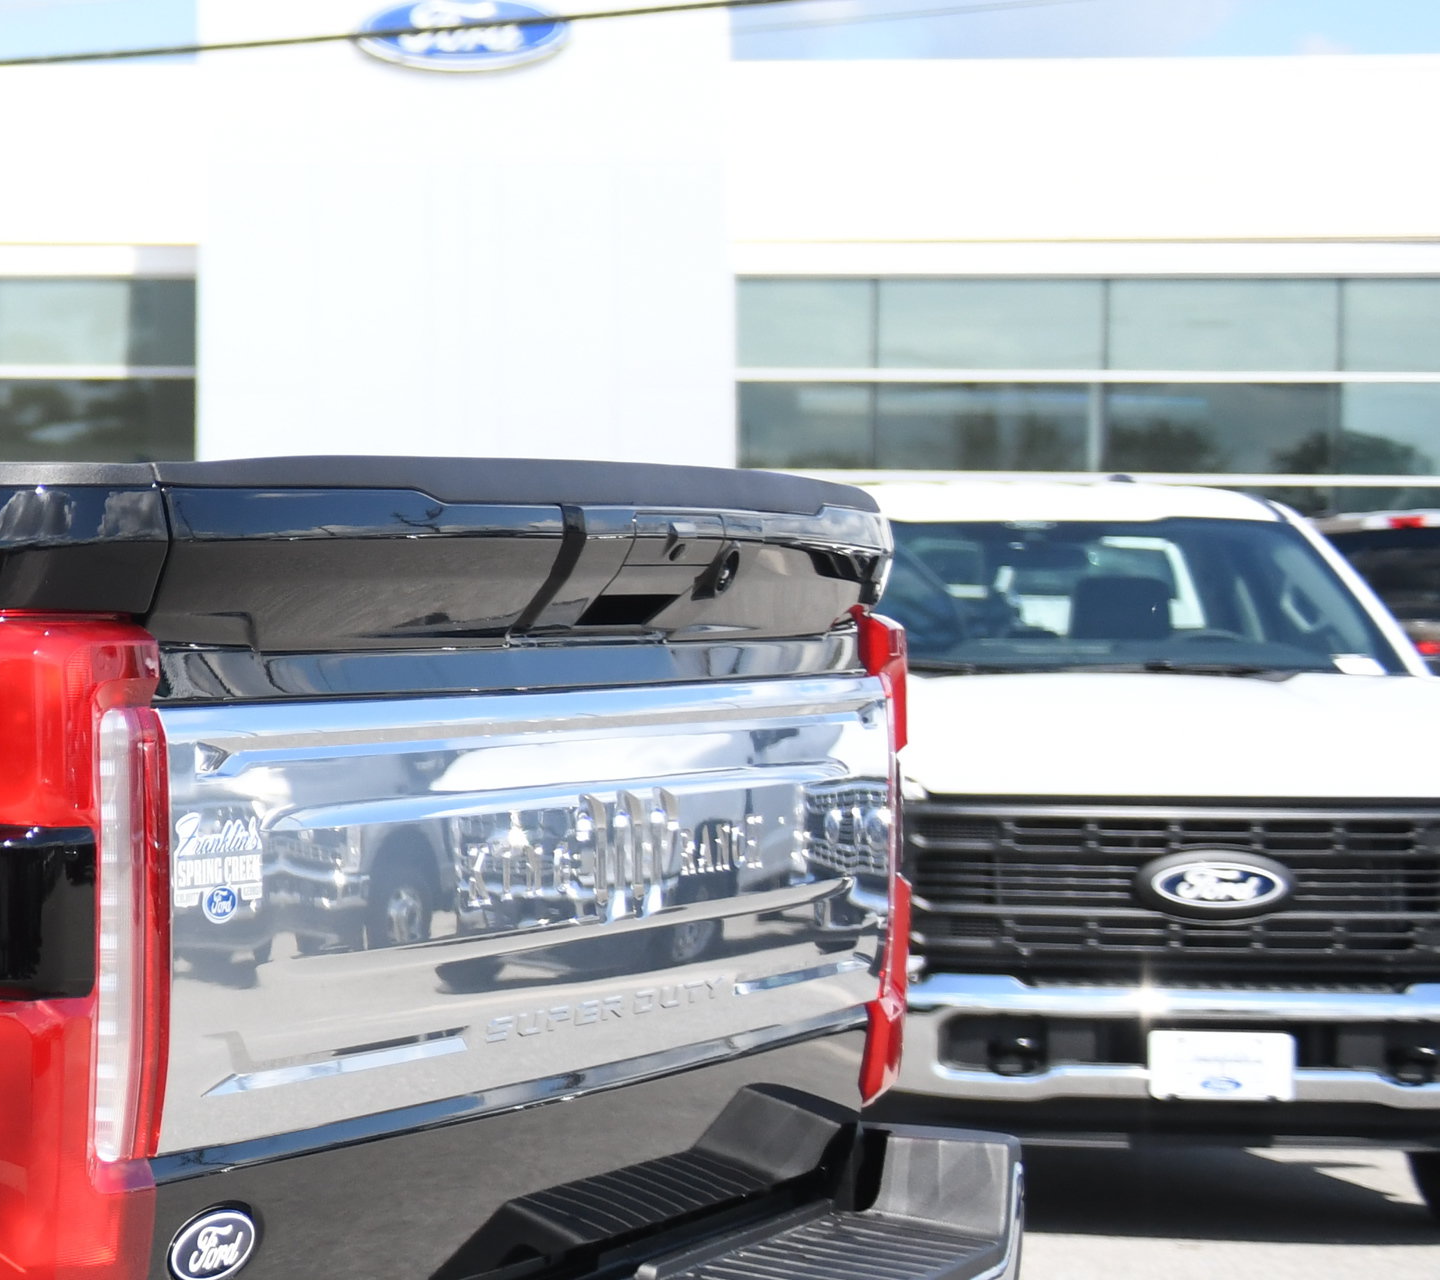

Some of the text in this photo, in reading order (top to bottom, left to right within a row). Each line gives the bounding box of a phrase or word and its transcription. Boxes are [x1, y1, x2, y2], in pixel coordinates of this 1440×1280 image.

[177, 853, 262, 888] SPRING CREEK
[1176, 868, 1262, 902] Ford
[211, 890, 234, 914] Ford
[486, 975, 726, 1044] SUPER DUTY
[188, 1223, 243, 1273] Ford
